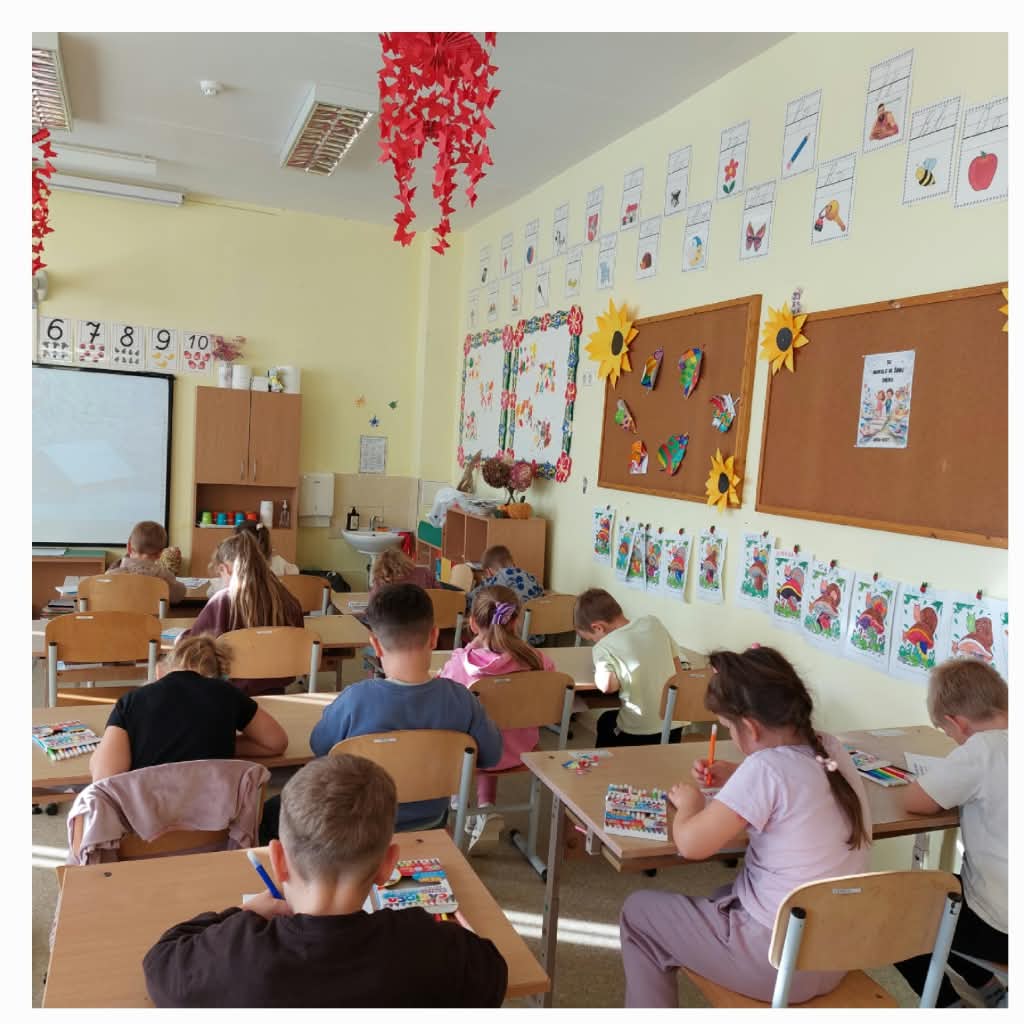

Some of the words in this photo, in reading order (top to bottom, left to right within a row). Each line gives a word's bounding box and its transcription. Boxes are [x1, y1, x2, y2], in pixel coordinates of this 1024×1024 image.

[47, 318, 64, 341] 6
[86, 321, 101, 344] 7
[120, 326, 134, 347] 8
[155, 329, 171, 350] 9
[188, 335, 209, 350] 10
